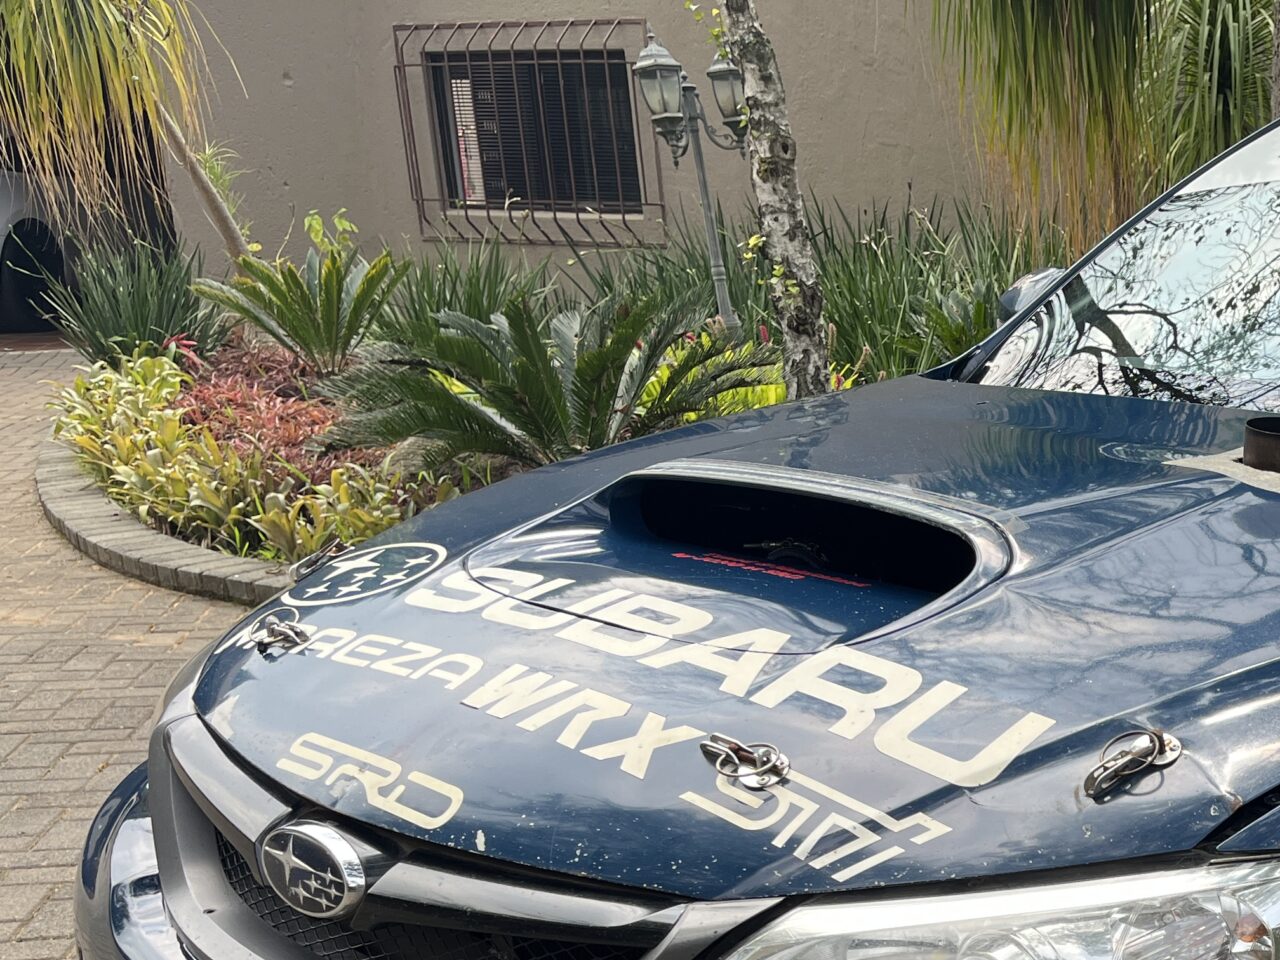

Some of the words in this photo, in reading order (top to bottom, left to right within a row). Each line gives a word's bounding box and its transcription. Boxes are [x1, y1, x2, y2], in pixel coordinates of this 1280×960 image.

[406, 566, 1057, 788] SUBARU
[463, 661, 706, 780] WRX
[275, 731, 465, 830] SRD
